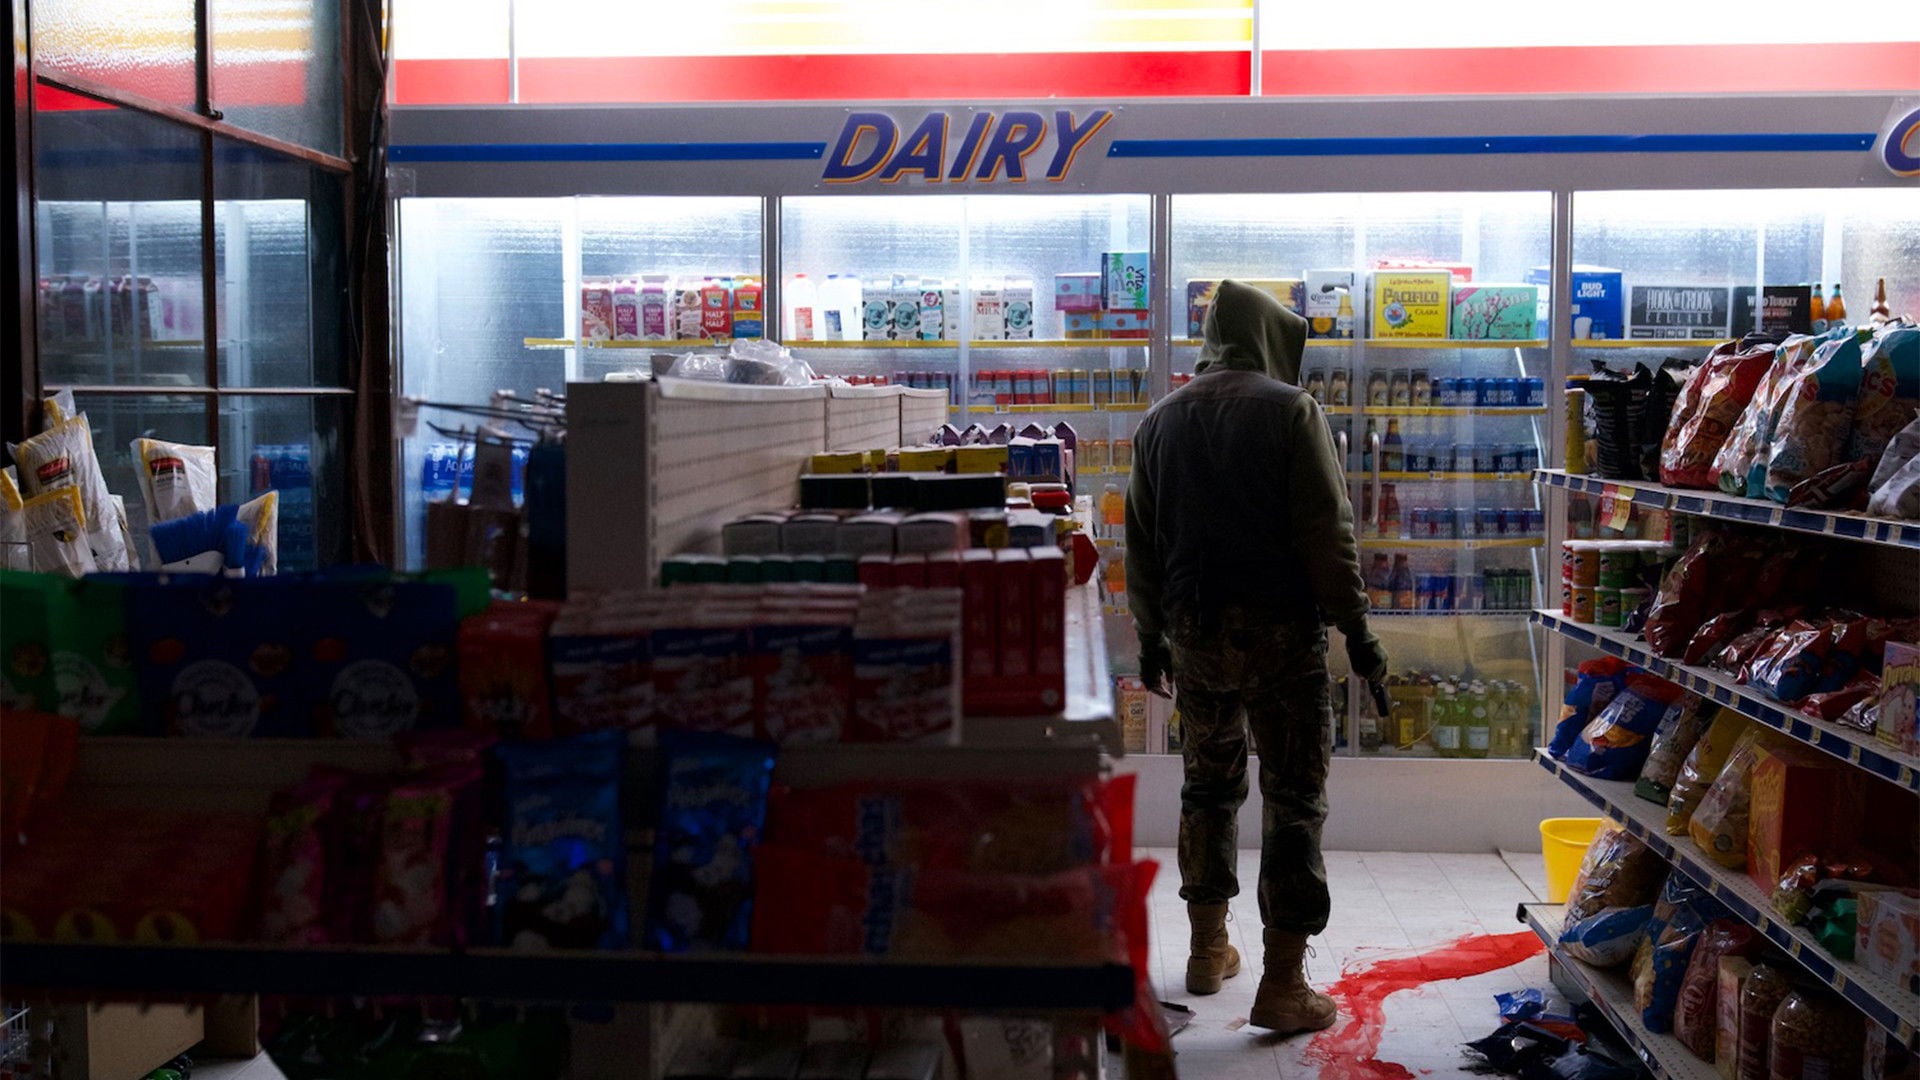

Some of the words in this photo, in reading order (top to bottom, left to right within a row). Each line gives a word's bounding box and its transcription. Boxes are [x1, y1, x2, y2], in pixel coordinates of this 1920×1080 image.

[822, 111, 1113, 183] DAIRY
[1135, 268, 1146, 291] VITA
[1581, 282, 1603, 290] BUD
[1577, 290, 1606, 298] LIGHT
[1646, 289, 1674, 310] HOOK
[1681, 289, 1713, 310] CROOK
[1747, 295, 1768, 307] WD
[976, 307, 1000, 315] MILK
